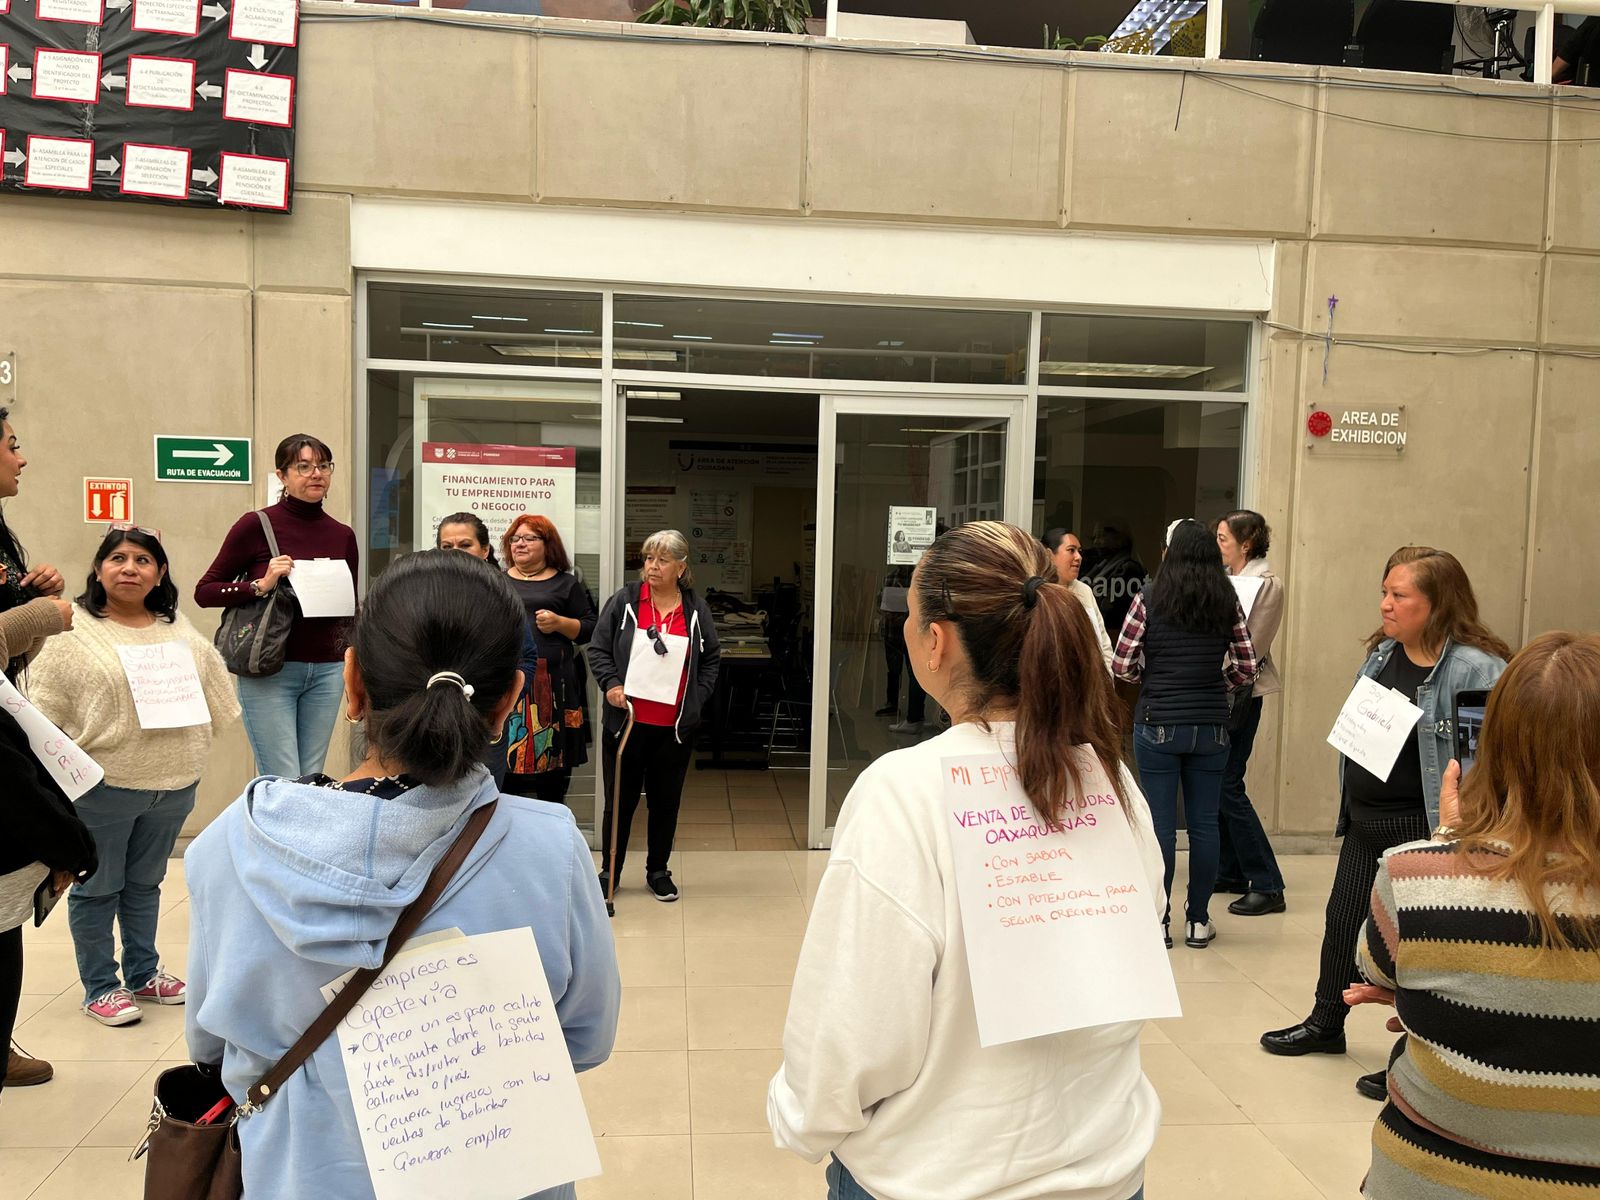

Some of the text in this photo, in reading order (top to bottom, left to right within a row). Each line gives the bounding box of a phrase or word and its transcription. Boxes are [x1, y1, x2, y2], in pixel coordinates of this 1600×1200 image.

[39, 148, 67, 156] ASAMBLEA
[1340, 411, 1399, 426] AREA DE
[1331, 429, 1407, 445] EXHIBICION
[167, 468, 241, 478] RUTA DE EVACUACIÓN
[89, 482, 127, 491] EXTINTOR
[442, 474, 556, 487] FINANCIAMIENTO PARA
[446, 488, 552, 499] TU EMPRENDIMIENTO
[471, 501, 526, 511] O NEGOCIO
[951, 766, 971, 786] MI
[953, 809, 1008, 828] VENTA
[1010, 805, 1032, 821] DE
[1025, 848, 1072, 865] SABOR
[995, 871, 1063, 887] ESTABLE
[996, 884, 1138, 908] CON POTENCIAL PARA
[999, 913, 1046, 928] SEGUIR
[421, 1019, 440, 1032] un
[489, 1017, 503, 1031] la
[471, 1041, 486, 1056] de
[502, 1079, 524, 1089] con
